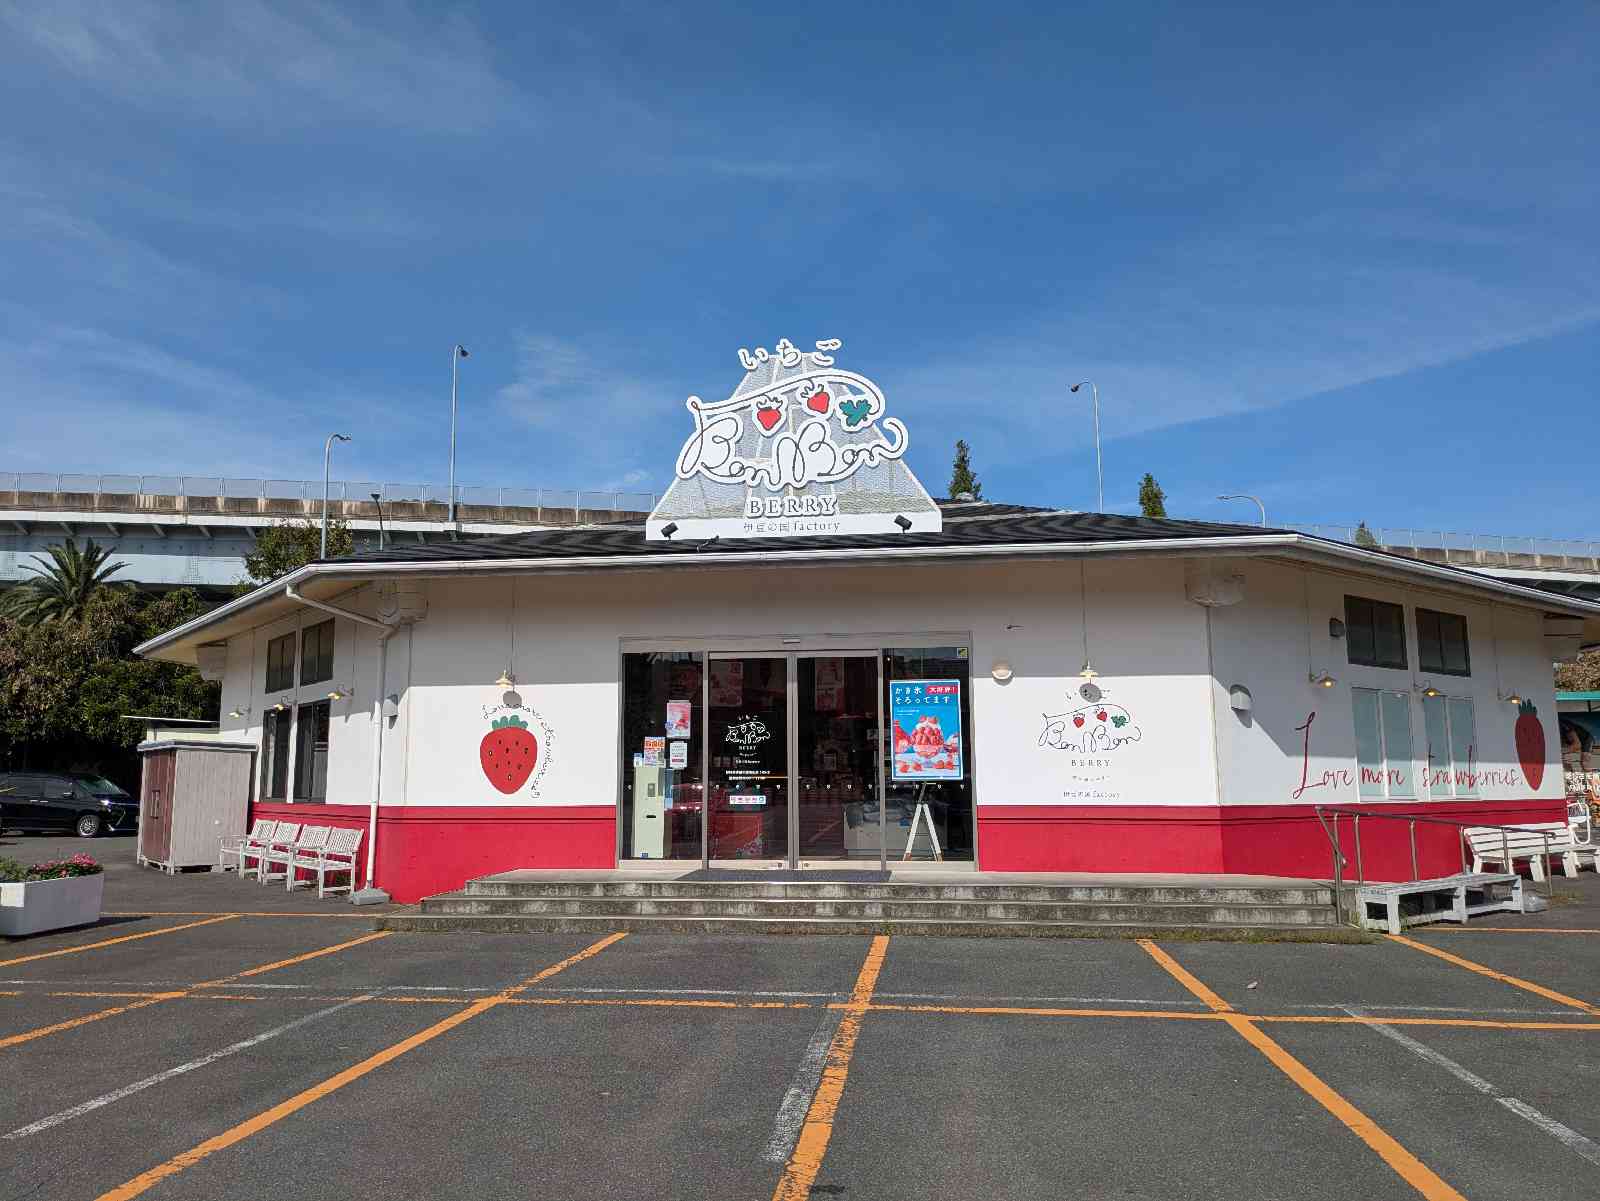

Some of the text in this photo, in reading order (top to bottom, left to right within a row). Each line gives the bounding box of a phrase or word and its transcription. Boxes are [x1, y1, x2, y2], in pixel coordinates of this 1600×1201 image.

[739, 339, 841, 367] いちご
[750, 496, 834, 514] BERRY
[1071, 759, 1111, 768] BERRY
[1292, 711, 1354, 800] Love
[1361, 767, 1406, 786] more
